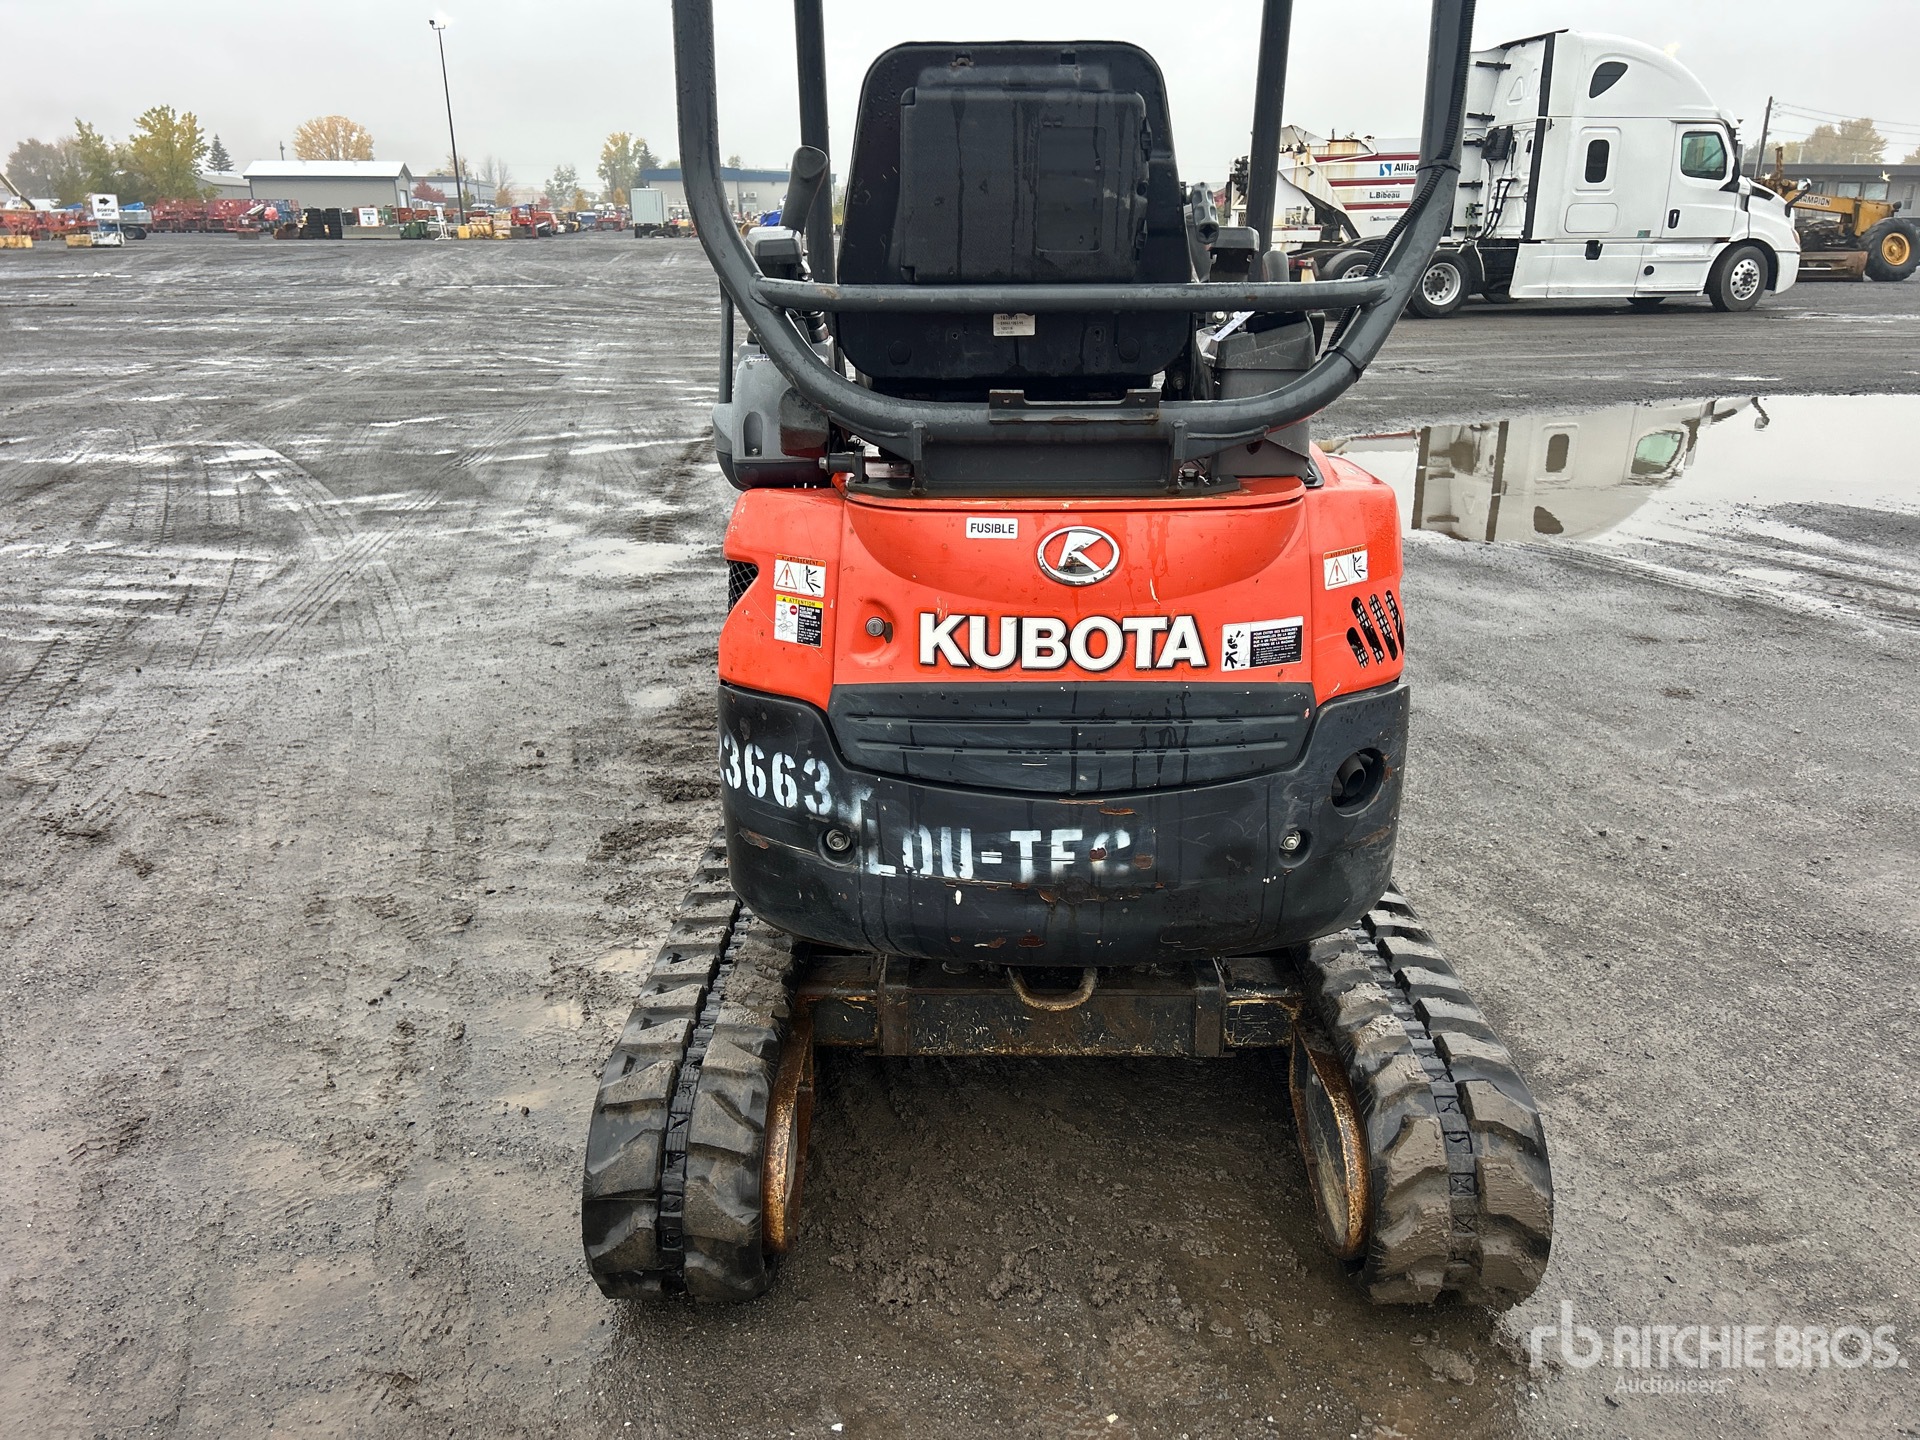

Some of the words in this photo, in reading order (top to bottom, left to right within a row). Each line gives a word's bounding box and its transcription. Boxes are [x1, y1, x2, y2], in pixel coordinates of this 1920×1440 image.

[970, 522, 1015, 534] FUSIBLE
[789, 598, 815, 606] ATTENTION
[919, 612, 1208, 672] KUBOTA
[719, 734, 832, 815] 3663
